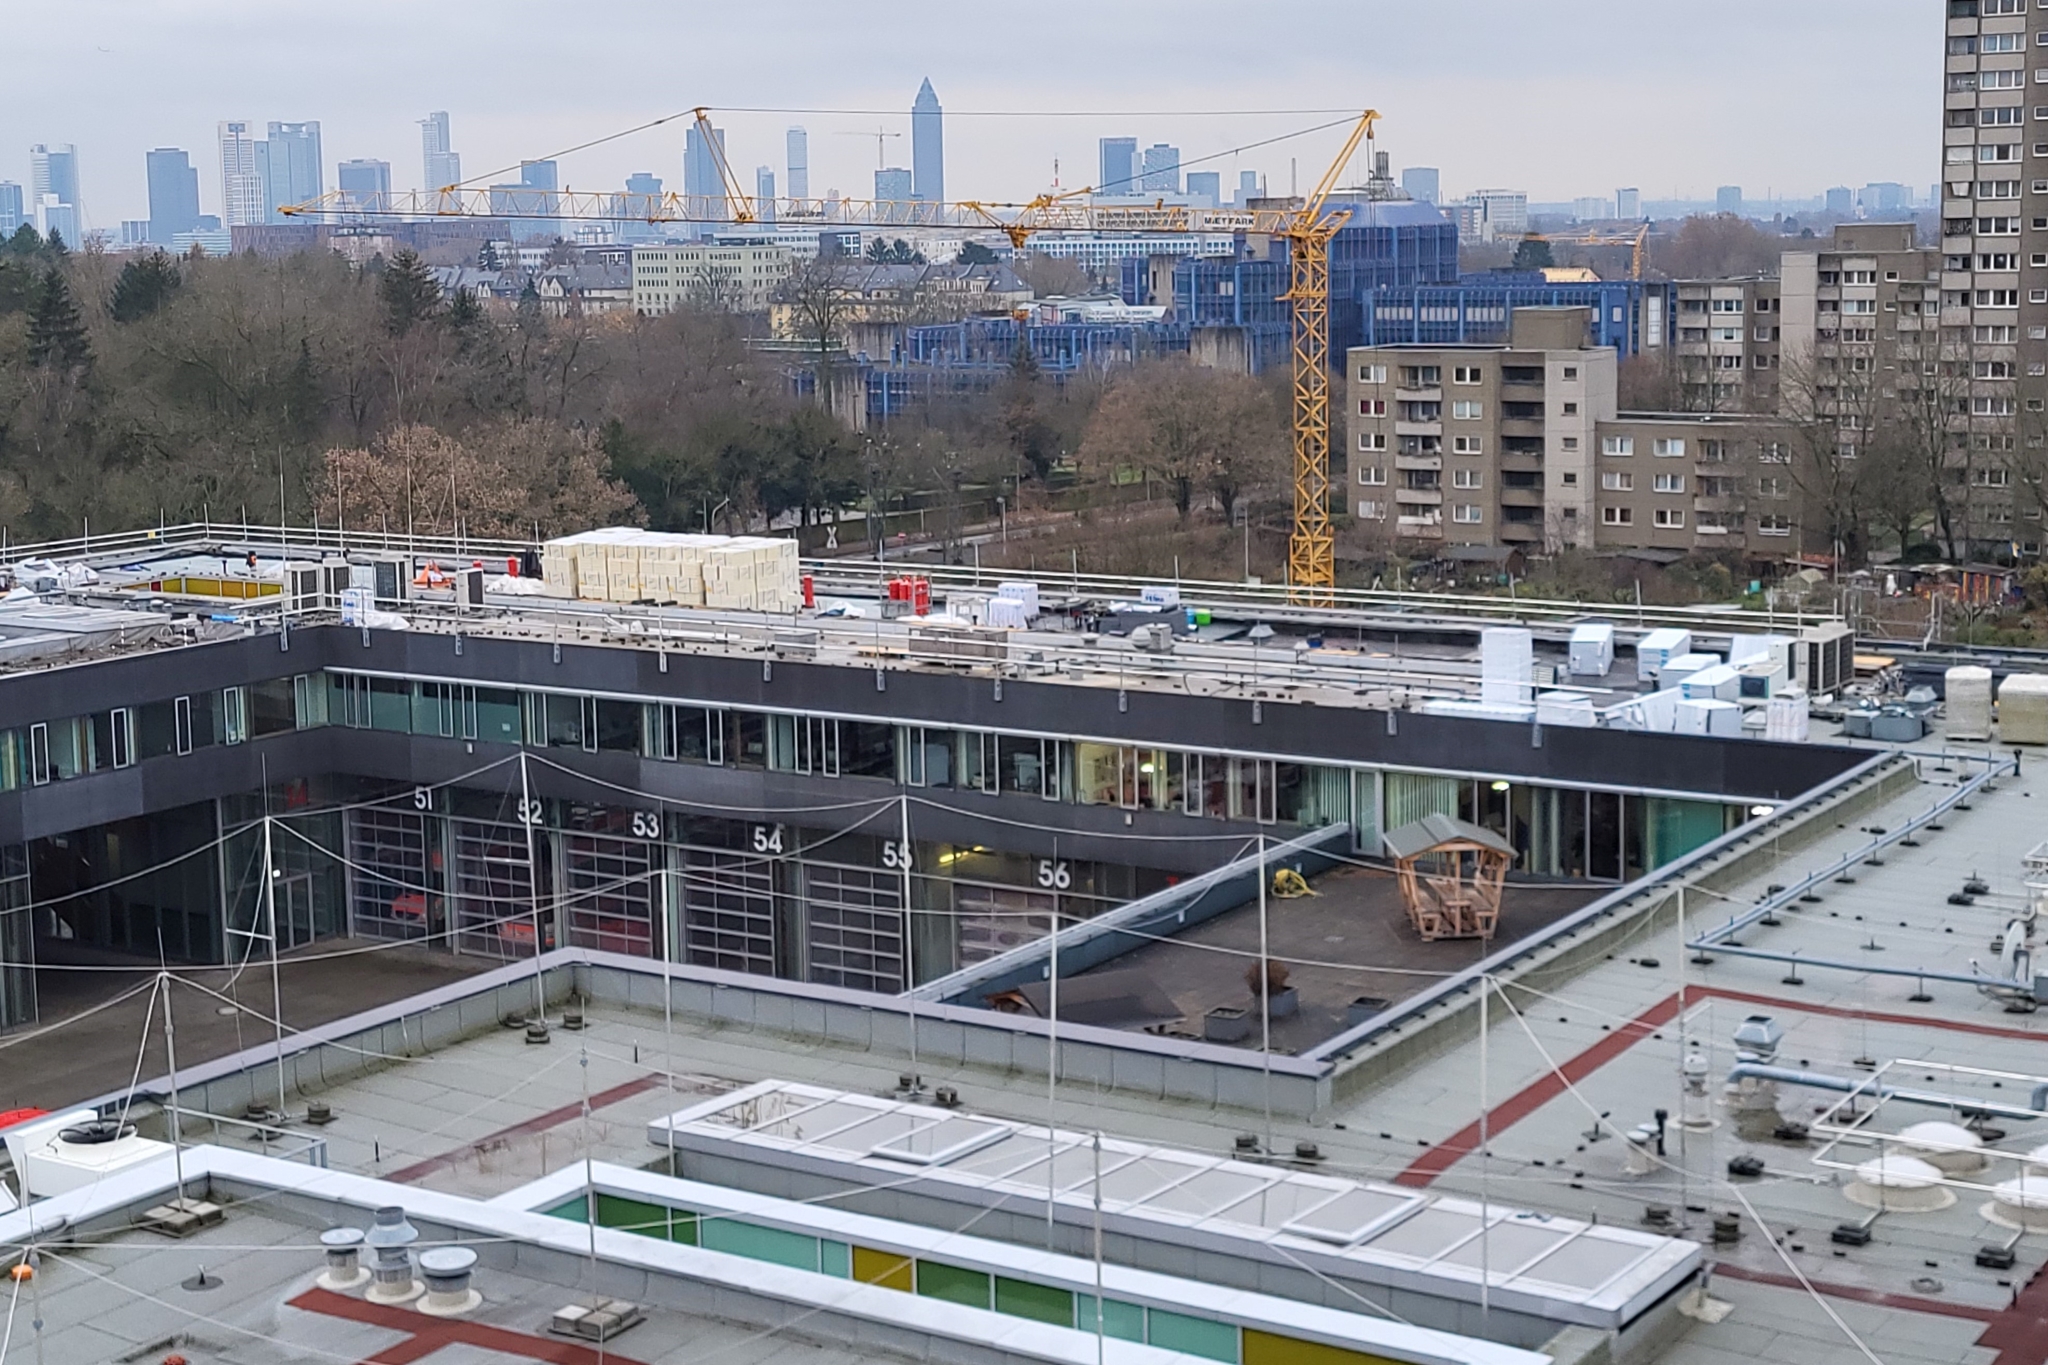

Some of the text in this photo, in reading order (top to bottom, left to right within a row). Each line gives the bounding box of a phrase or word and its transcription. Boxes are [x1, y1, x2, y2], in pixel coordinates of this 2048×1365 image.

[414, 786, 433, 811] 51
[517, 798, 543, 825] 52
[632, 811, 660, 839] 53
[753, 825, 783, 854] 54
[882, 841, 913, 870] 55
[1037, 859, 1071, 889] 56
